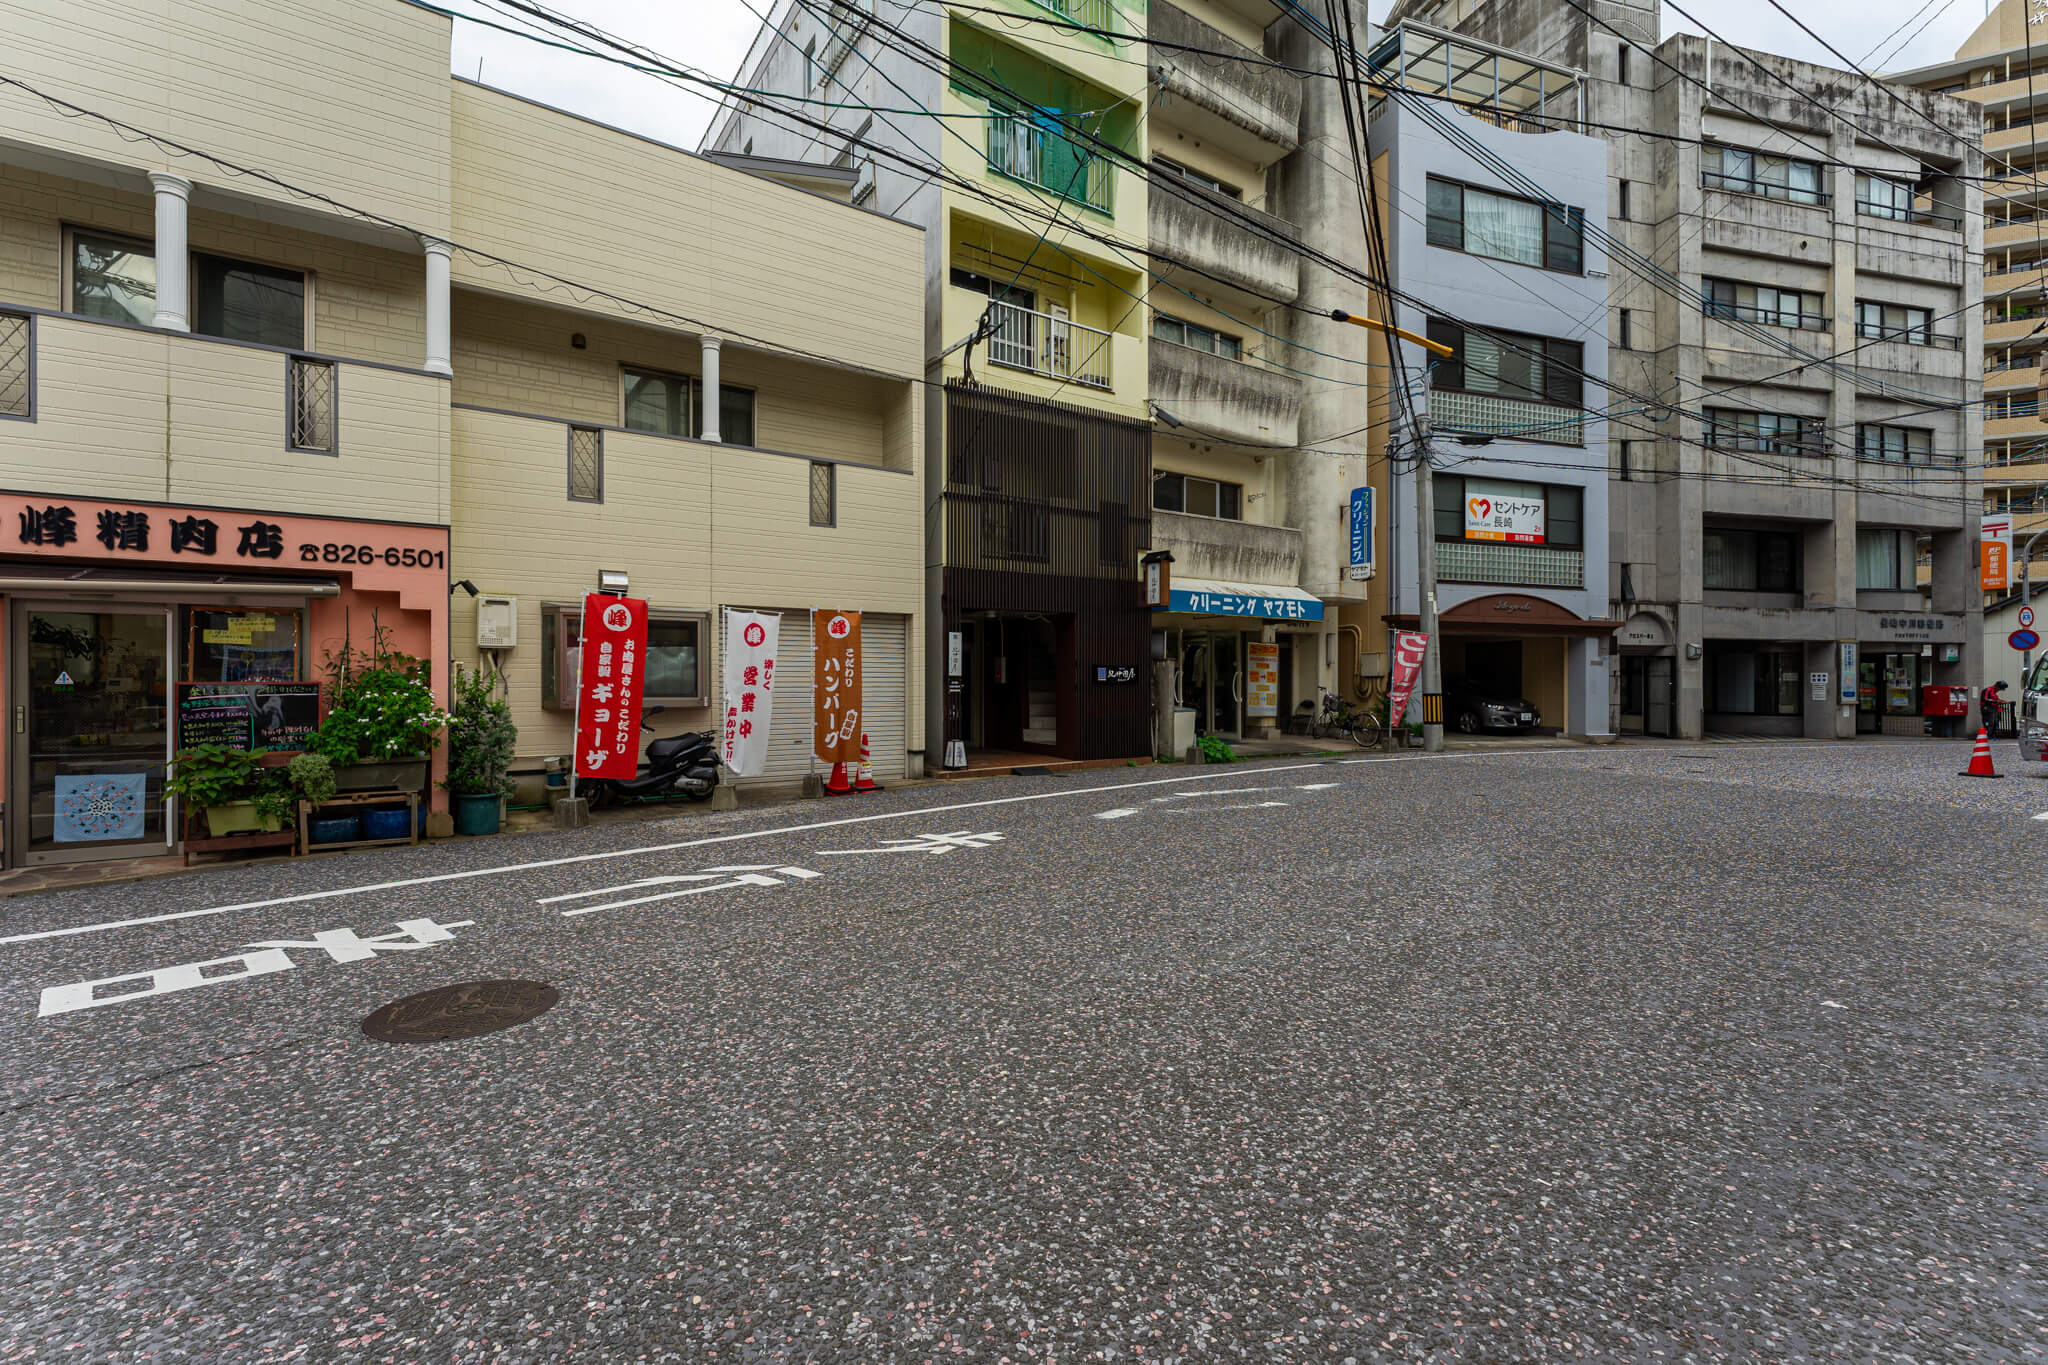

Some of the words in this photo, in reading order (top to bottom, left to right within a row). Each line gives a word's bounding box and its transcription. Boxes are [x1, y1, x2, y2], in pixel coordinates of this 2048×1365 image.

[1493, 500, 1541, 517] セントケア
[1493, 516, 1513, 529] 長崎
[18, 505, 285, 560] 峰精肉店
[1351, 500, 1364, 563] クリーニング
[322, 543, 444, 570] 826-6501
[607, 609, 627, 628] 峰
[1189, 593, 1257, 615] クリーニング
[1263, 599, 1306, 618] ヤマモト
[763, 659, 774, 691] 楽しく
[845, 648, 854, 688] こだわり
[616, 638, 635, 754] お肉屋さんのこだわり
[739, 665, 759, 739] 営業中
[824, 657, 841, 749] ハンバーグ
[586, 683, 614, 770] ギョーザ
